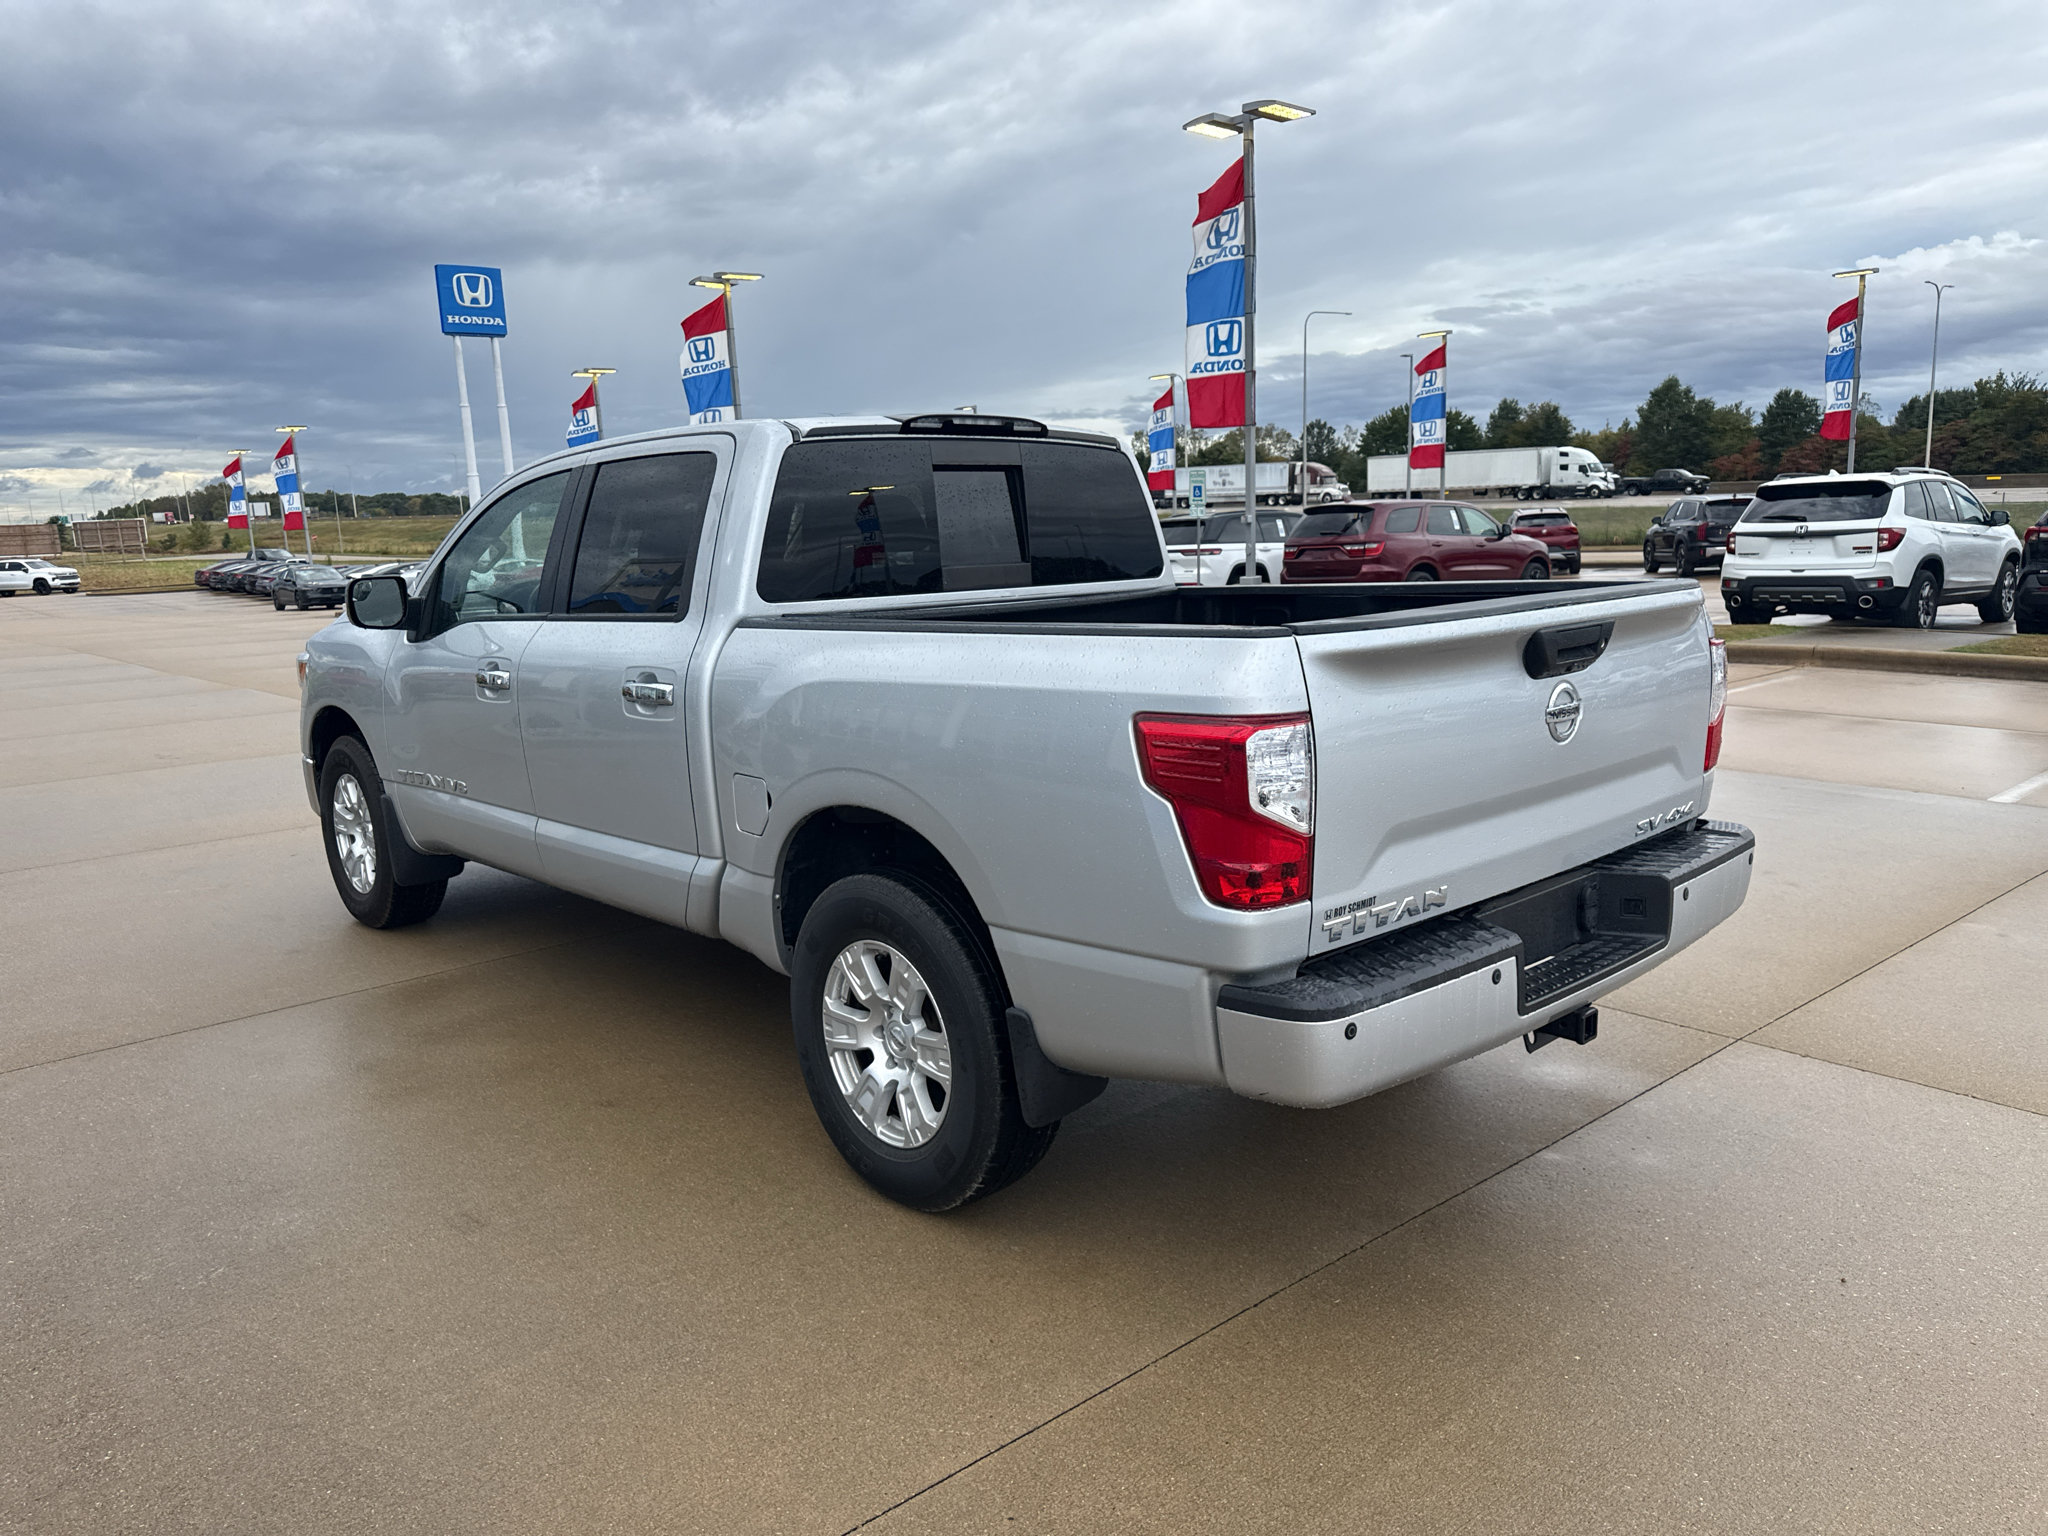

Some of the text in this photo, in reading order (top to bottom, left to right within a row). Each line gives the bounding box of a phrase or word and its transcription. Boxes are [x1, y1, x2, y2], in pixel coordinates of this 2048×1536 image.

[447, 315, 504, 326] HONDA
[398, 768, 446, 789] TITAN
[1635, 813, 1663, 837] SV
[1321, 885, 1448, 943] TITAN
[1334, 895, 1377, 918] ROY SCHMIDT
